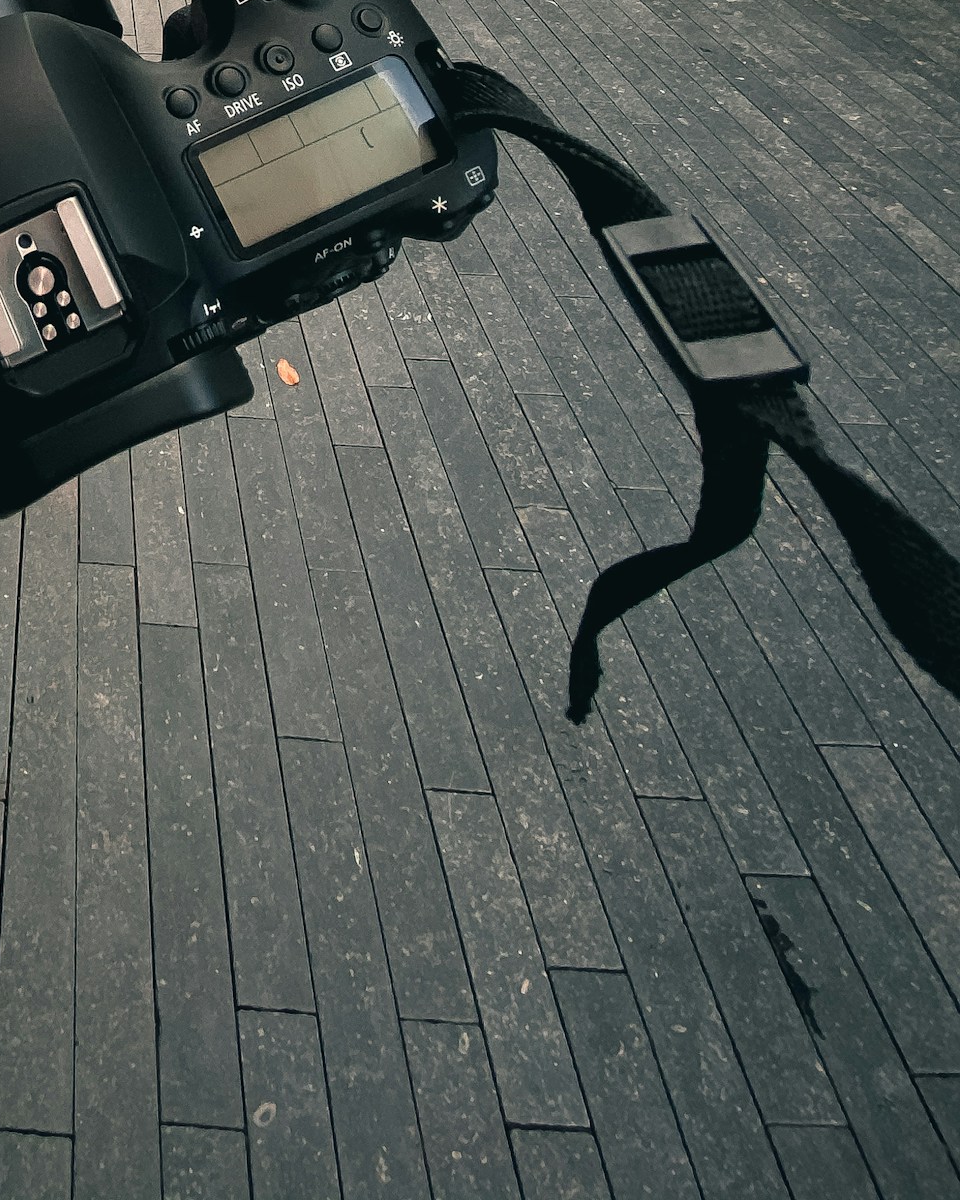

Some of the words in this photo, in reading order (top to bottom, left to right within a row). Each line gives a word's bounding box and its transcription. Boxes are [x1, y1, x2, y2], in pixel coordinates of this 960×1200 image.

[281, 73, 305, 92] ISO
[223, 92, 263, 118] DRIVE
[185, 119, 202, 137] AF
[314, 236, 353, 264] AF-ON
